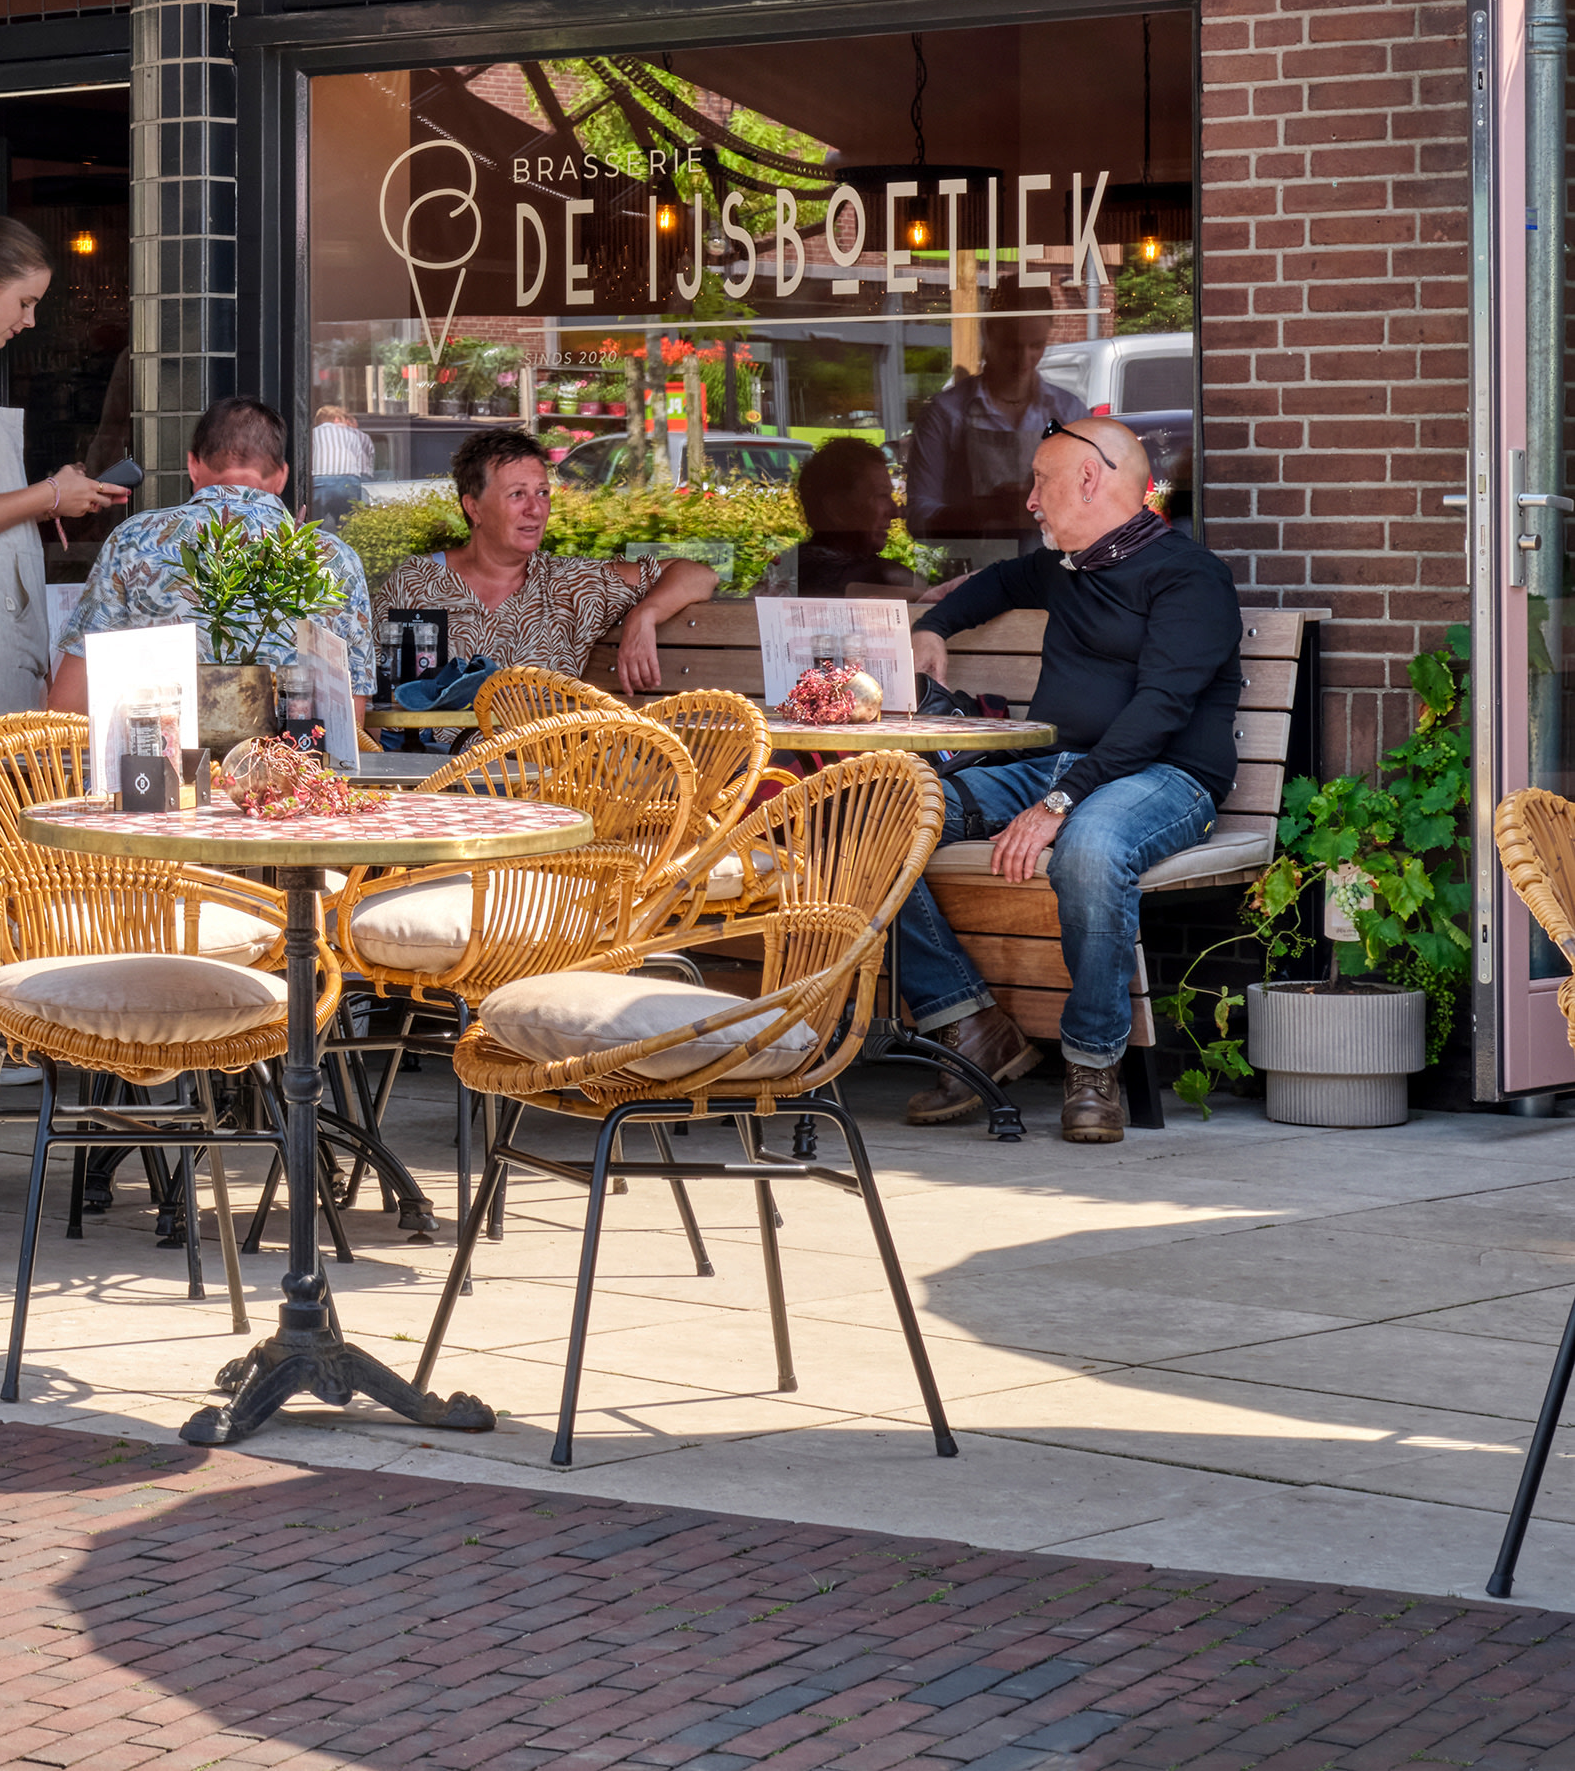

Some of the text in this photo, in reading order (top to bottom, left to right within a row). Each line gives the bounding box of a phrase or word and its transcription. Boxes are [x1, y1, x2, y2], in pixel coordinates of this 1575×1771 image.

[513, 147, 703, 183] BRASSERIE
[516, 170, 1110, 307] DE IJSBOETIEK
[523, 350, 618, 366] SINDS 2020
